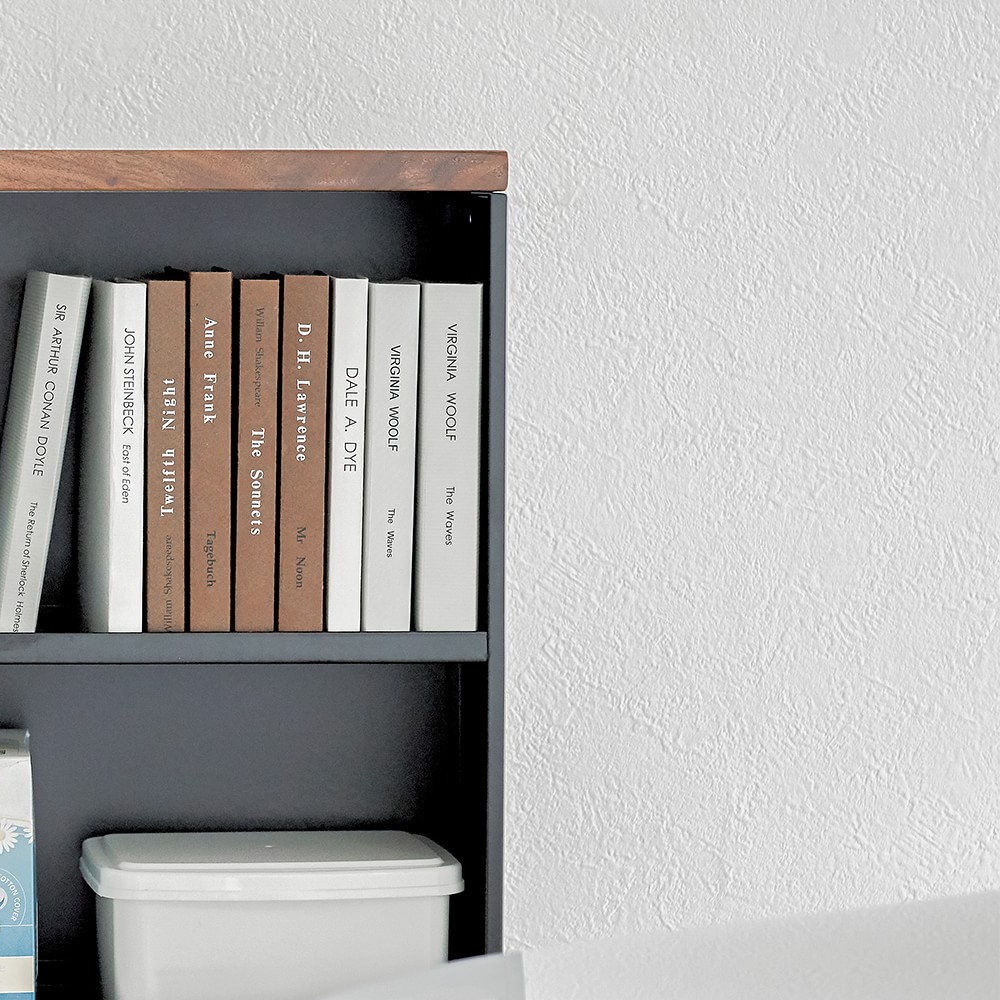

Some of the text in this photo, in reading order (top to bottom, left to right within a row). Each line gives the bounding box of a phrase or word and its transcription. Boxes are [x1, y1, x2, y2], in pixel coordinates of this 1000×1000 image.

[32, 303, 67, 477] SIR ARTHUR CONAN DOYLE
[123, 327, 135, 435] JOHN STEINBECK
[203, 316, 218, 425] Anne Frank
[252, 347, 264, 408] Shakespeare
[296, 322, 312, 463] D. H. Lawrence
[343, 367, 358, 472] DALE A. DYE
[388, 344, 401, 452] VIRGINIA WOOLF
[445, 323, 458, 441] VIRGINIA WOOLF
[122, 443, 132, 504] East of Eden
[160, 377, 176, 517] Twelfth Night
[250, 428, 265, 536] The Sonnets
[12, 501, 38, 633] The Return of Sherlock Holmes
[163, 535, 174, 595] Shakespeare
[203, 531, 216, 587] Tagebuch
[296, 526, 306, 589] Mr Noon
[386, 508, 396, 558] The Waves
[445, 486, 455, 546] The Waves
[10, 897, 21, 921] COVER
